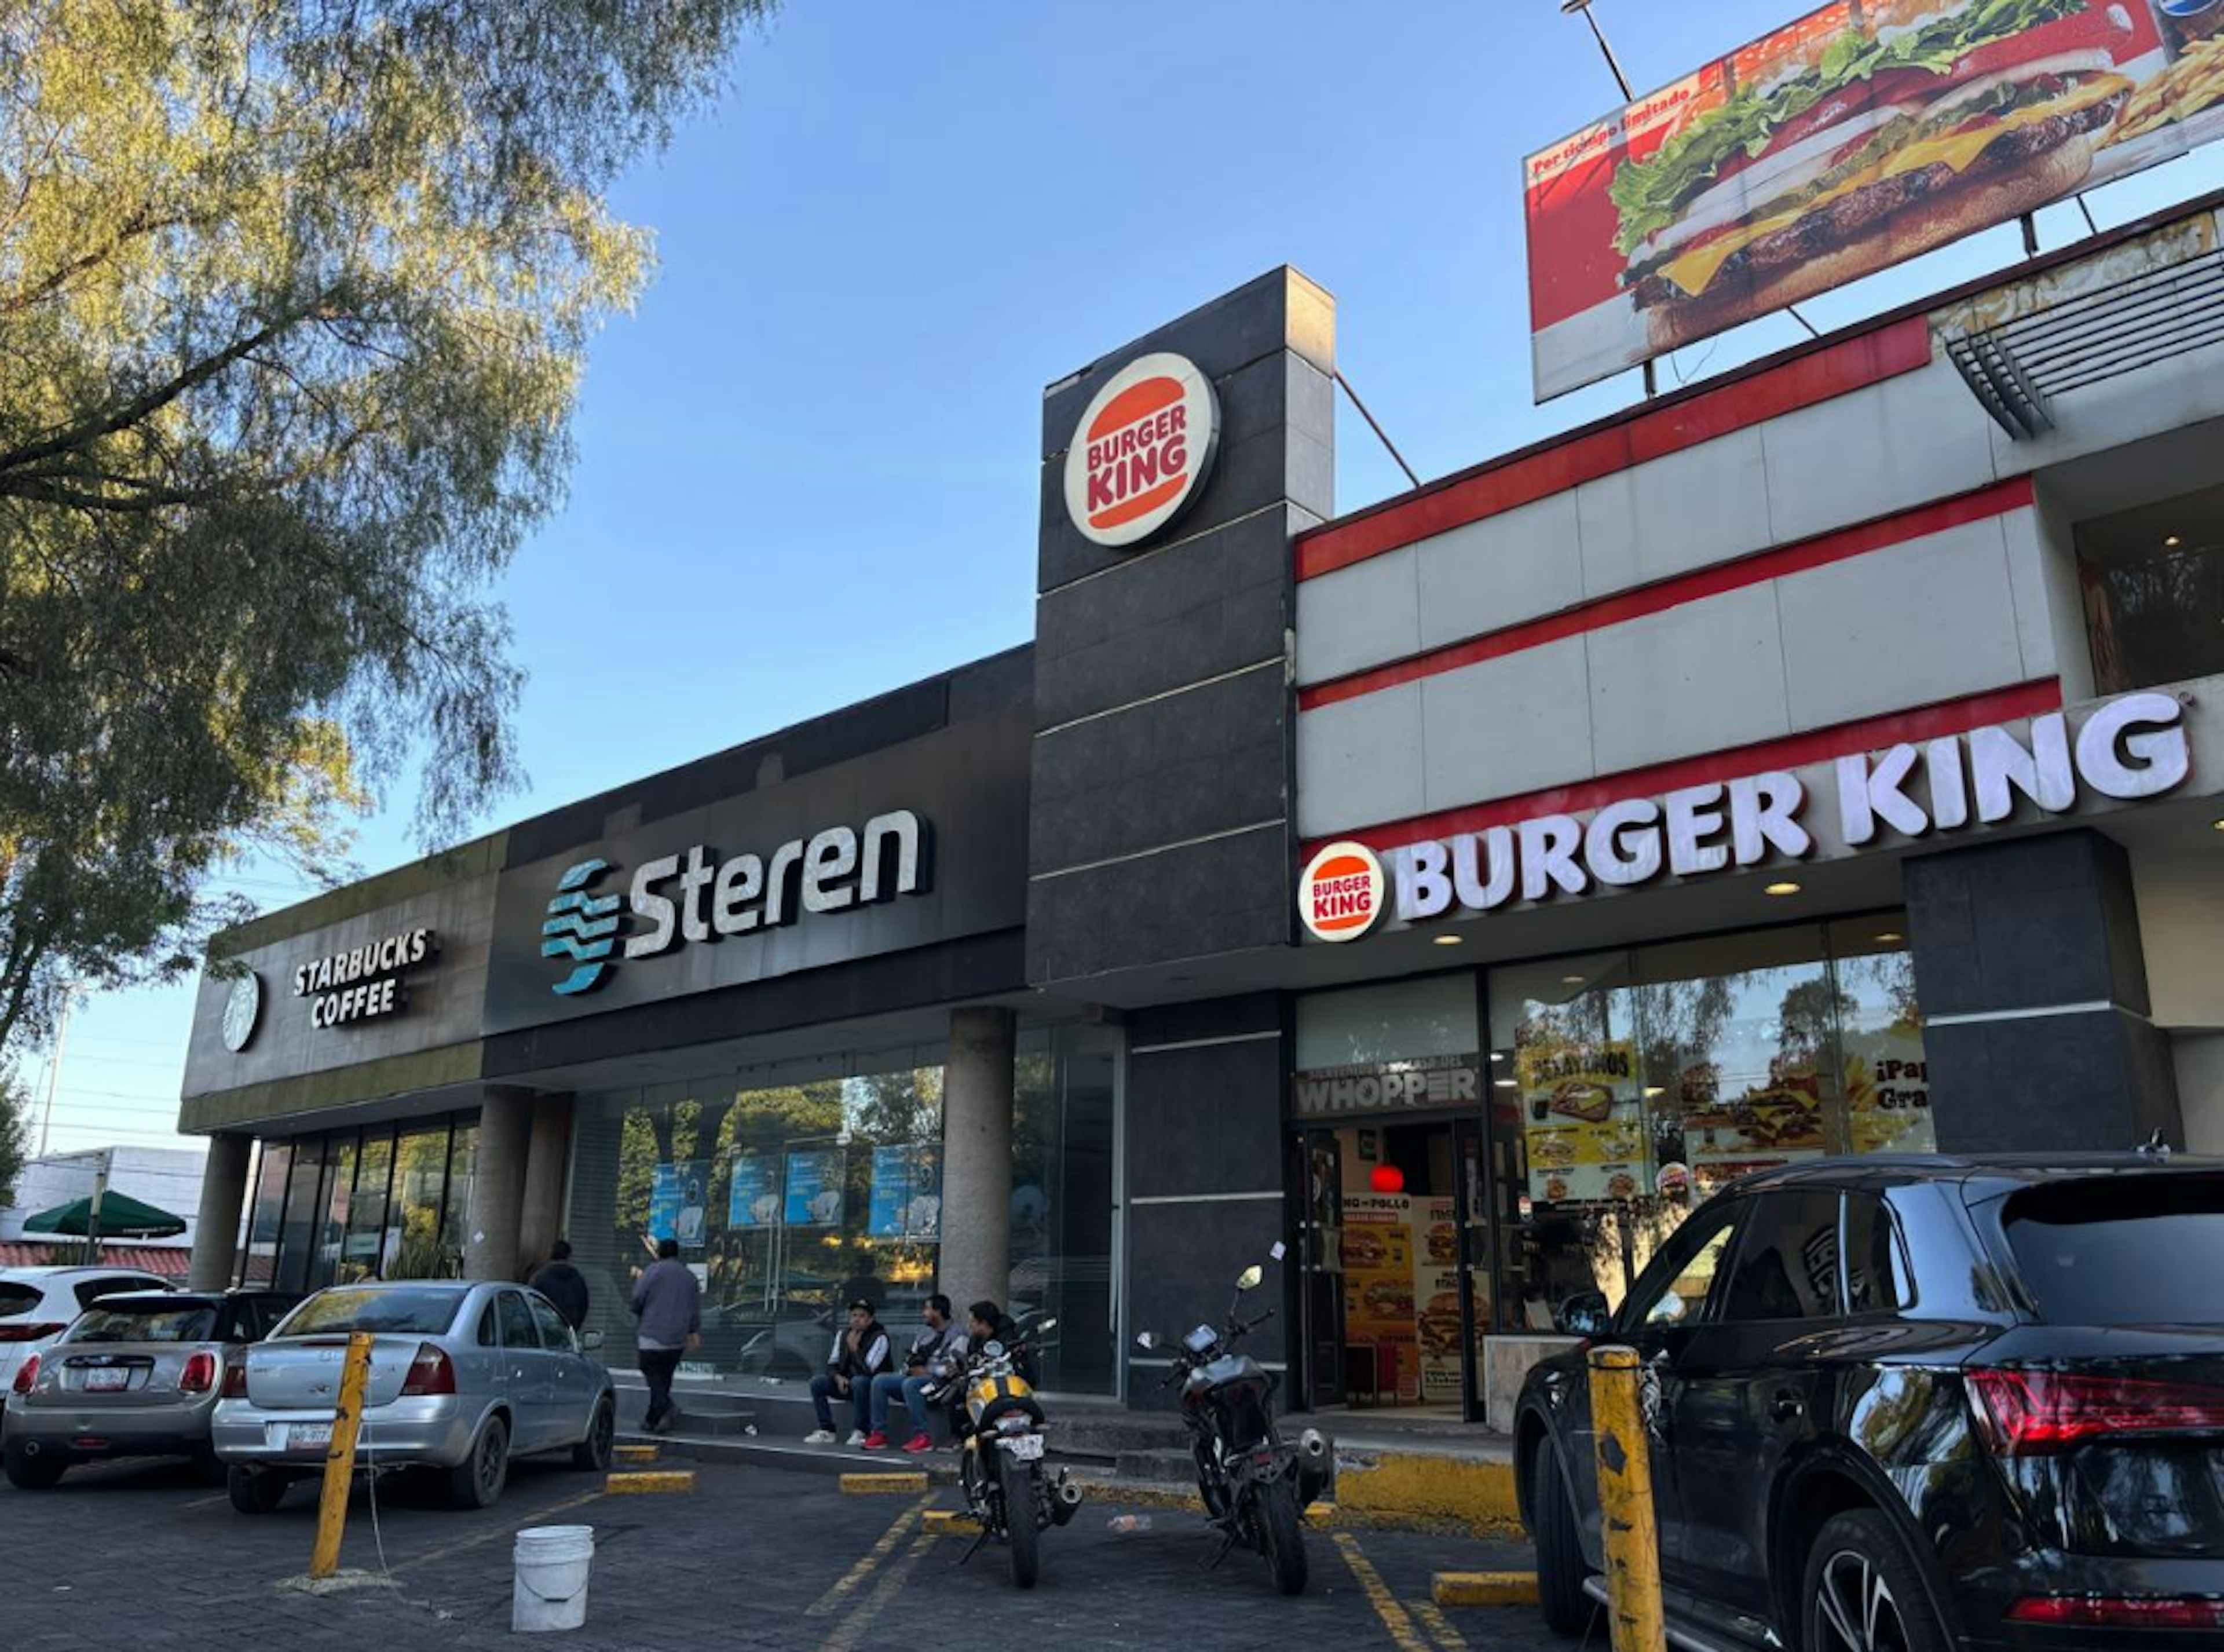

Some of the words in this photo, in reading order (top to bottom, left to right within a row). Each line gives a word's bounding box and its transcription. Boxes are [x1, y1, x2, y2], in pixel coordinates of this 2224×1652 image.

[1534, 153, 1560, 173] Por
[1563, 125, 1616, 158] tiempo
[1621, 89, 1689, 131] limitado
[1088, 405, 1186, 471] BURGER
[1089, 436, 1187, 511] KING
[1396, 772, 1810, 922] BURGER
[1836, 693, 2189, 846] KING
[625, 810, 918, 959] Steren
[1313, 875, 1370, 898] BURGER
[1314, 891, 1371, 919] KING
[294, 929, 427, 996] STARBUCKS
[312, 979, 396, 1028] COFFEE
[1297, 1068, 1476, 1113] WHOPPER
